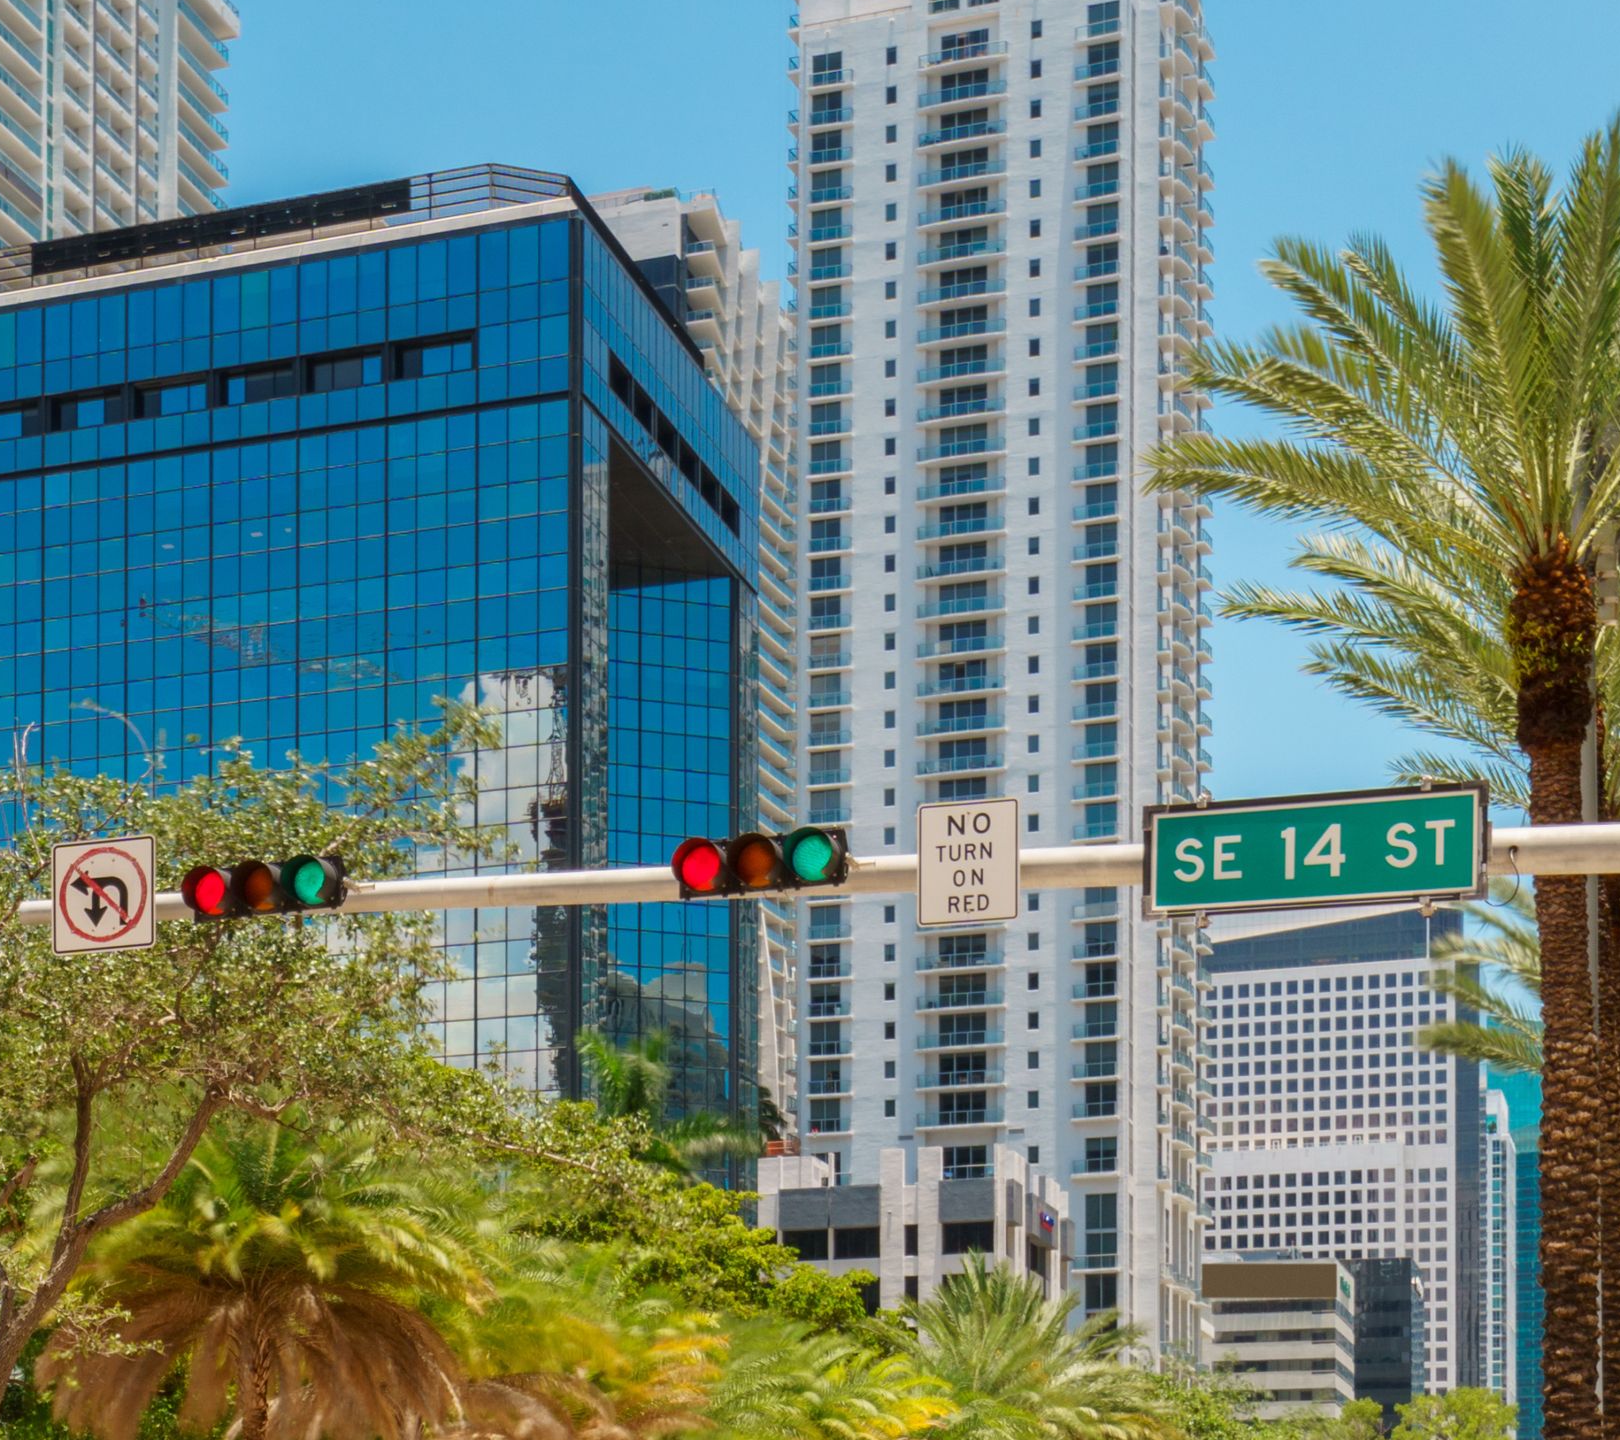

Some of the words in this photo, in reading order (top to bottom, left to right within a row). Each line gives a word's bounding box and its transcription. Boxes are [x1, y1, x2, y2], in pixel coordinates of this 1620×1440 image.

[947, 812, 991, 836] NO
[935, 842, 992, 862] TURN
[1173, 835, 1243, 882] SE
[1280, 823, 1346, 880] 14
[1384, 819, 1456, 869] ST
[953, 868, 984, 887] ON
[948, 894, 990, 914] RED
